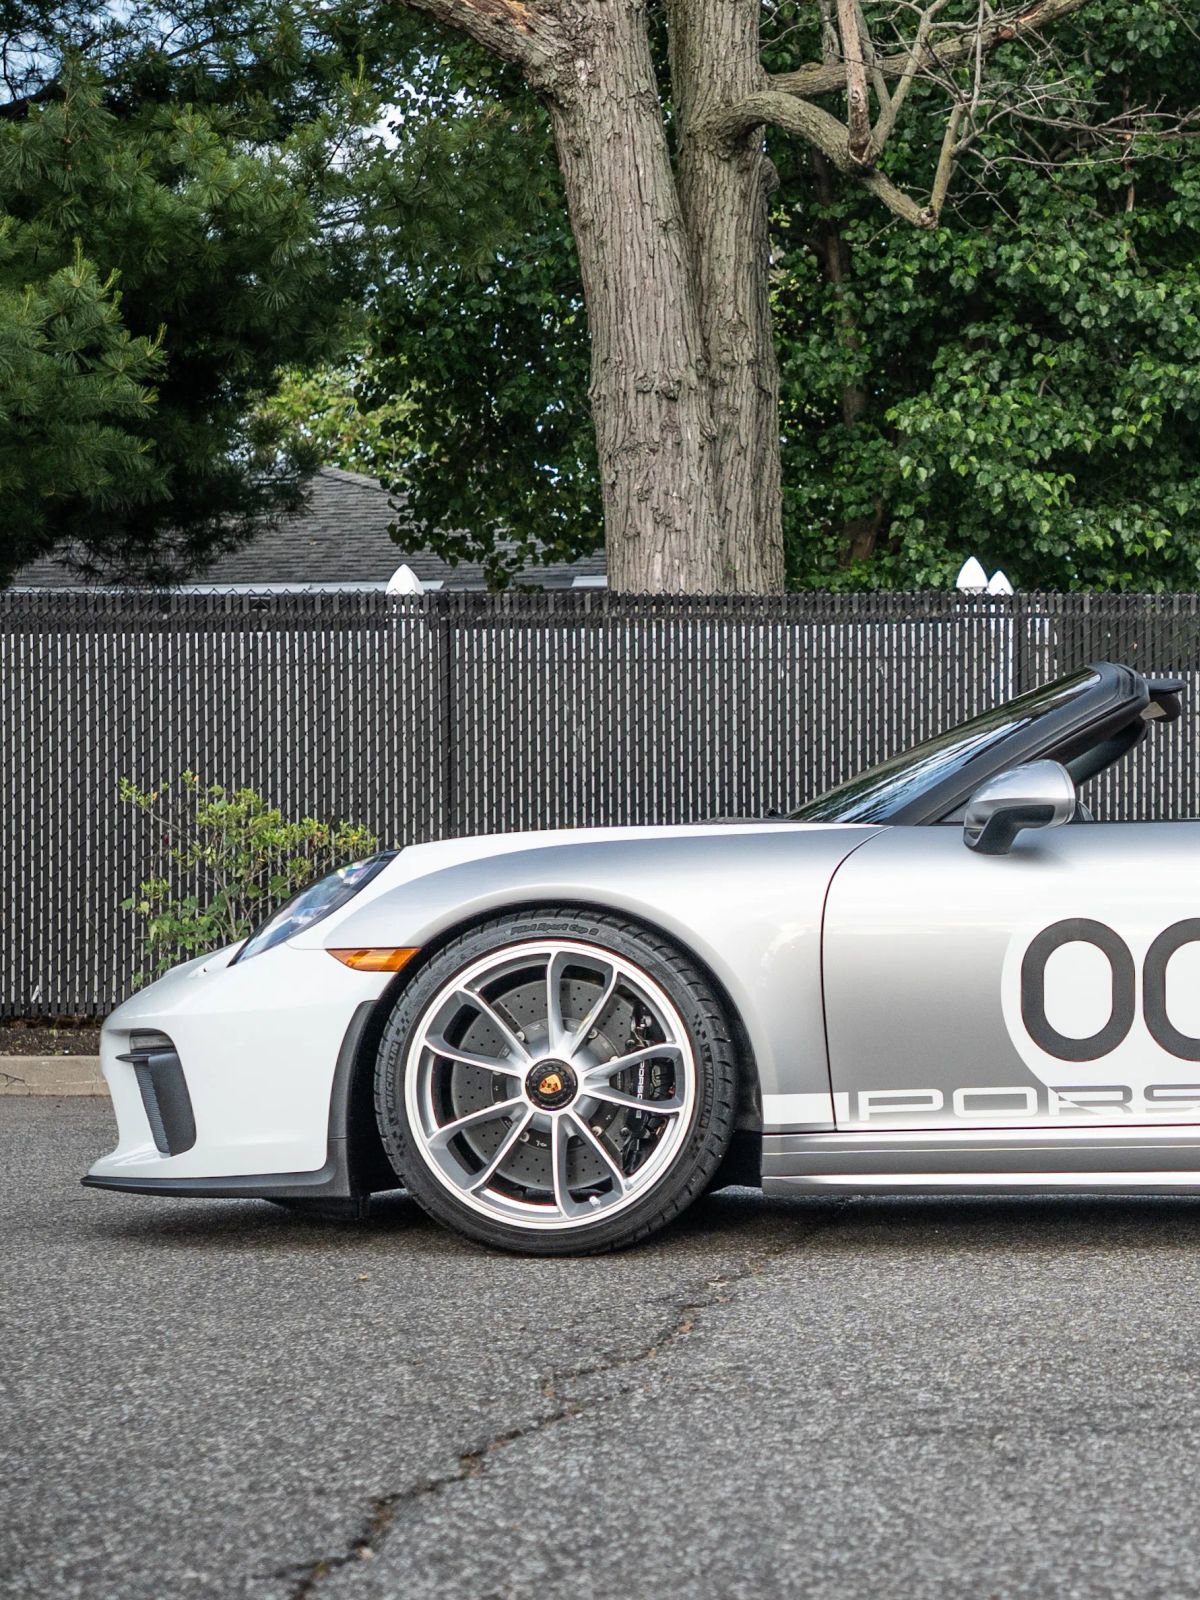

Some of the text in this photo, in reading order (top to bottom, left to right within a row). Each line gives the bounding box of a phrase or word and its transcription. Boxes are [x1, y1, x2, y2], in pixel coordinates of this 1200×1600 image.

[538, 922, 568, 931] Sport
[569, 924, 588, 933] Cup
[386, 1042, 400, 1109] MICHELIN
[701, 1060, 713, 1126] MICHELIN
